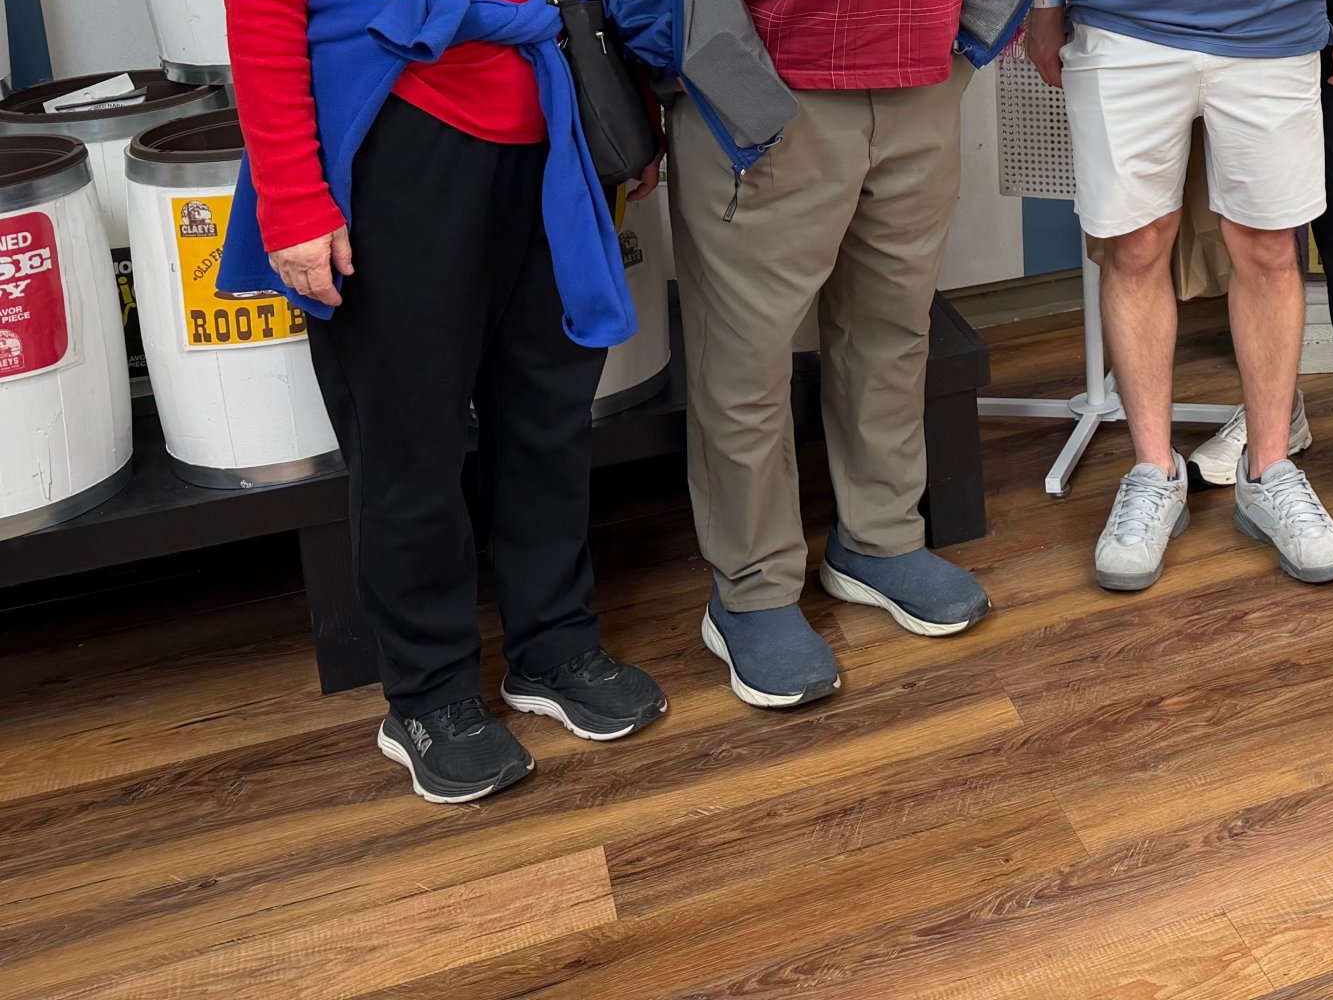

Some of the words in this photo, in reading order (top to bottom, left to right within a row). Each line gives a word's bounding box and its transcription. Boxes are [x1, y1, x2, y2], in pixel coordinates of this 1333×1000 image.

[181, 224, 216, 234] CLAEYS
[194, 258, 213, 279] OLD
[2, 312, 30, 324] PIECE
[190, 304, 275, 343] ROOT
